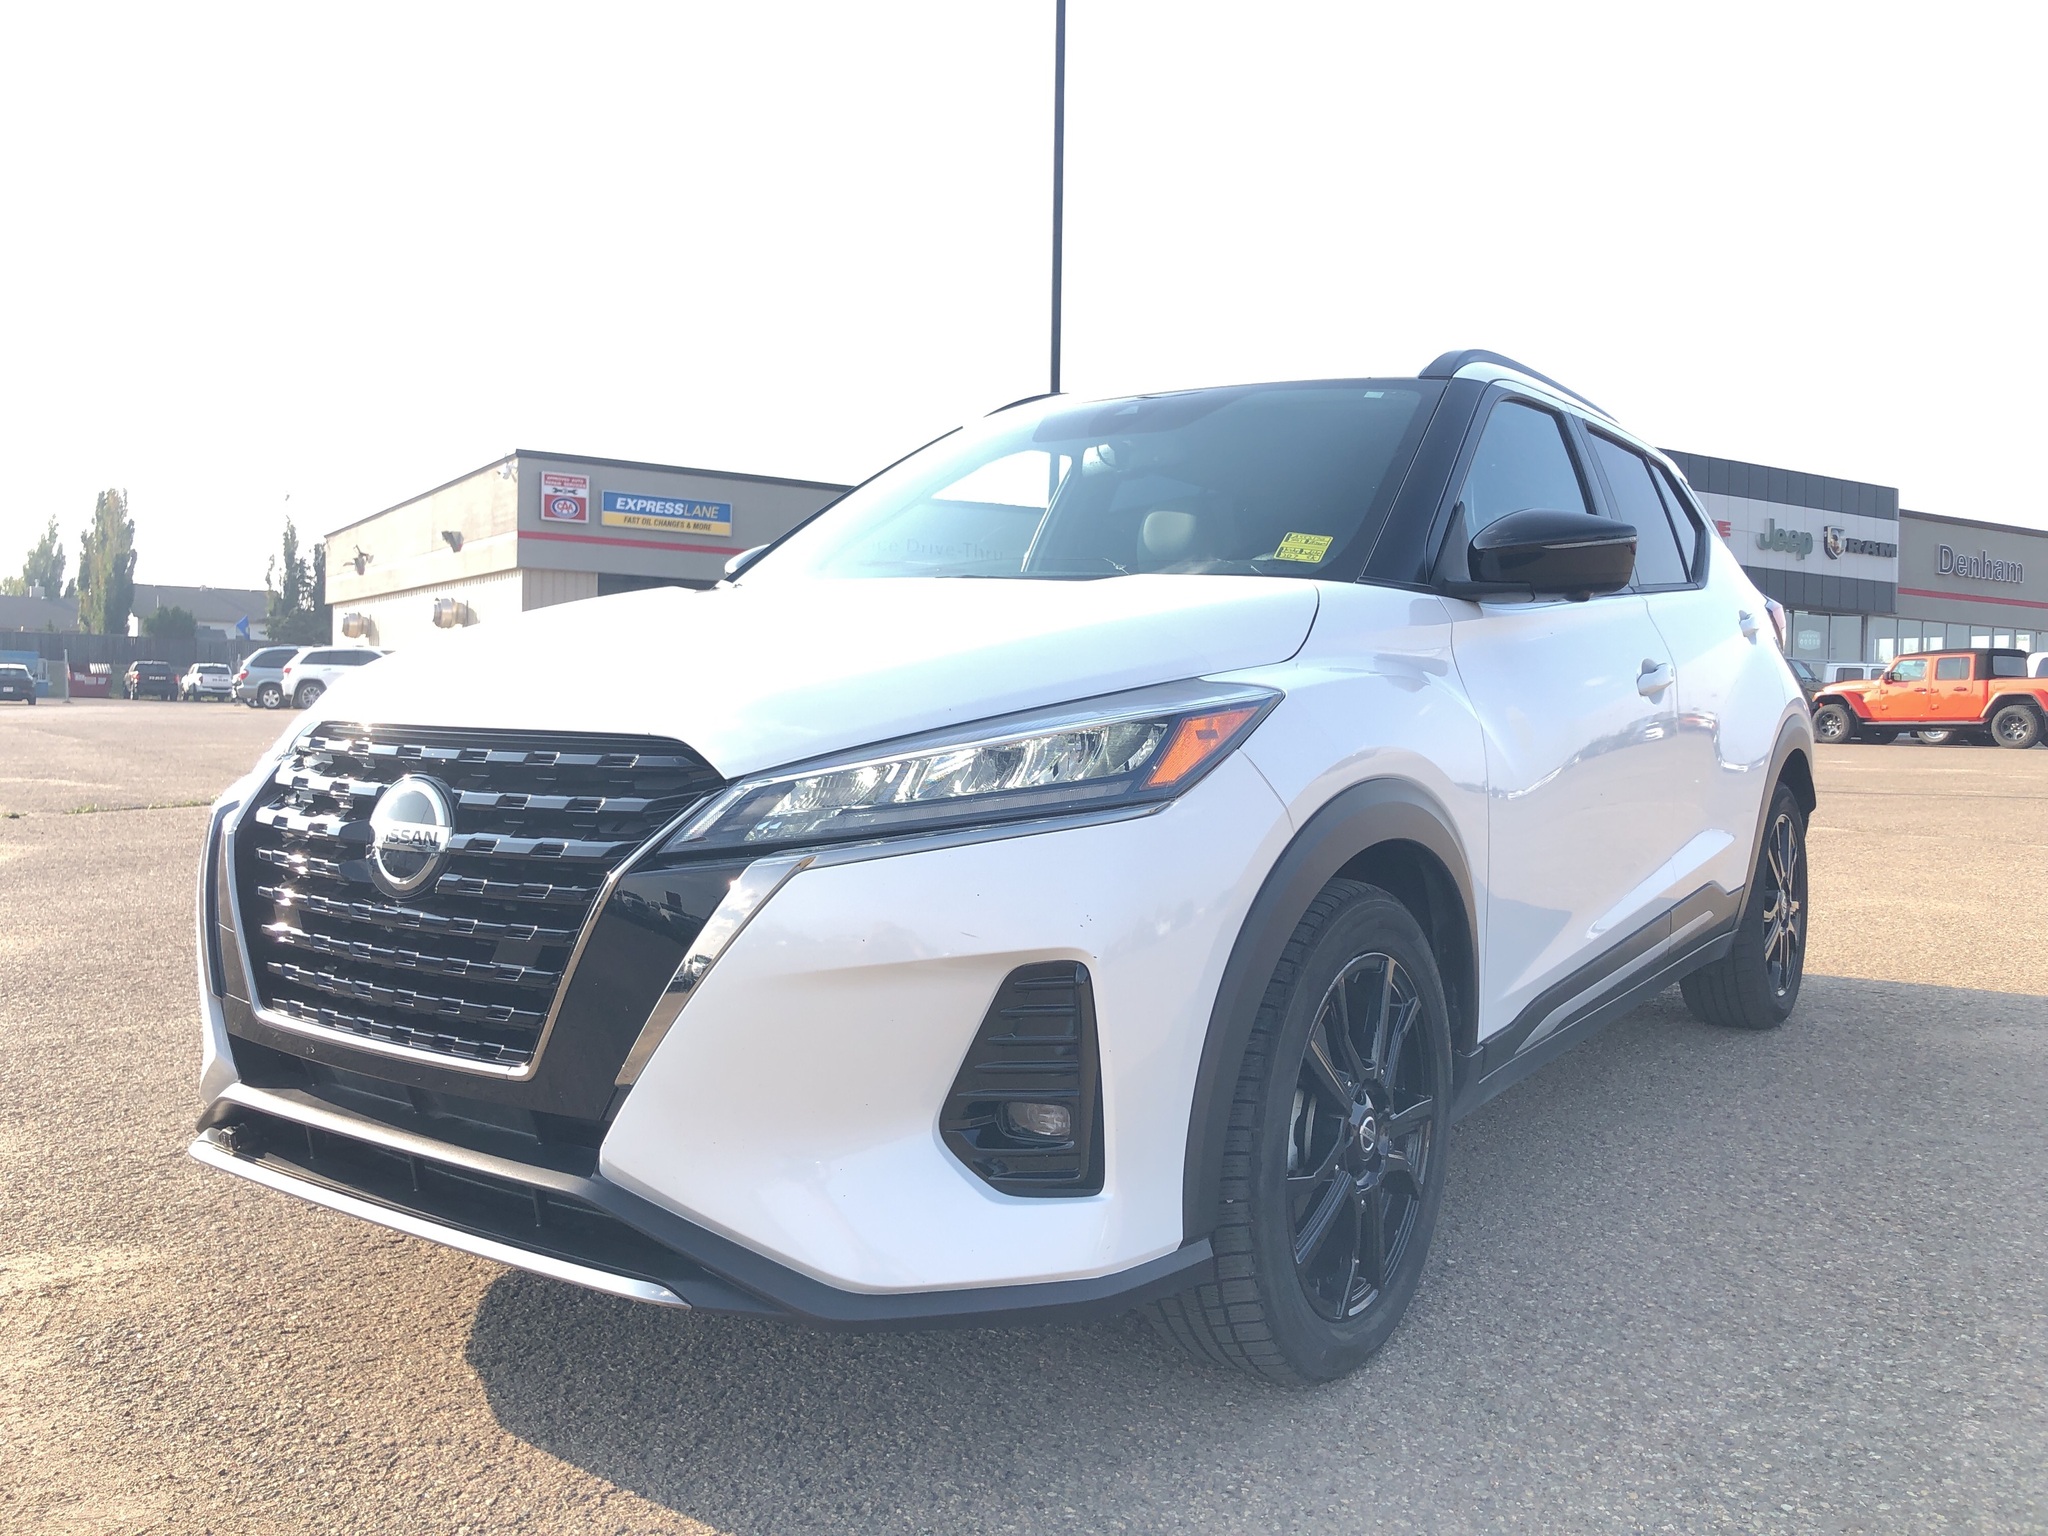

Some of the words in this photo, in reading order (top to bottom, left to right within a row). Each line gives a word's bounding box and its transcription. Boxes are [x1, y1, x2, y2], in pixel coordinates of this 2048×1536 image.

[557, 501, 573, 513] CAA
[616, 497, 719, 519] EXPRESSLANE
[624, 516, 640, 524] FAST
[641, 518, 652, 526] OIL
[654, 519, 685, 528] CHANGES
[693, 523, 712, 531] MORE
[1756, 518, 1813, 561] Jeep
[1845, 537, 1897, 558] RAM
[1937, 543, 2025, 584] Denham
[375, 828, 438, 846] ISSAN
